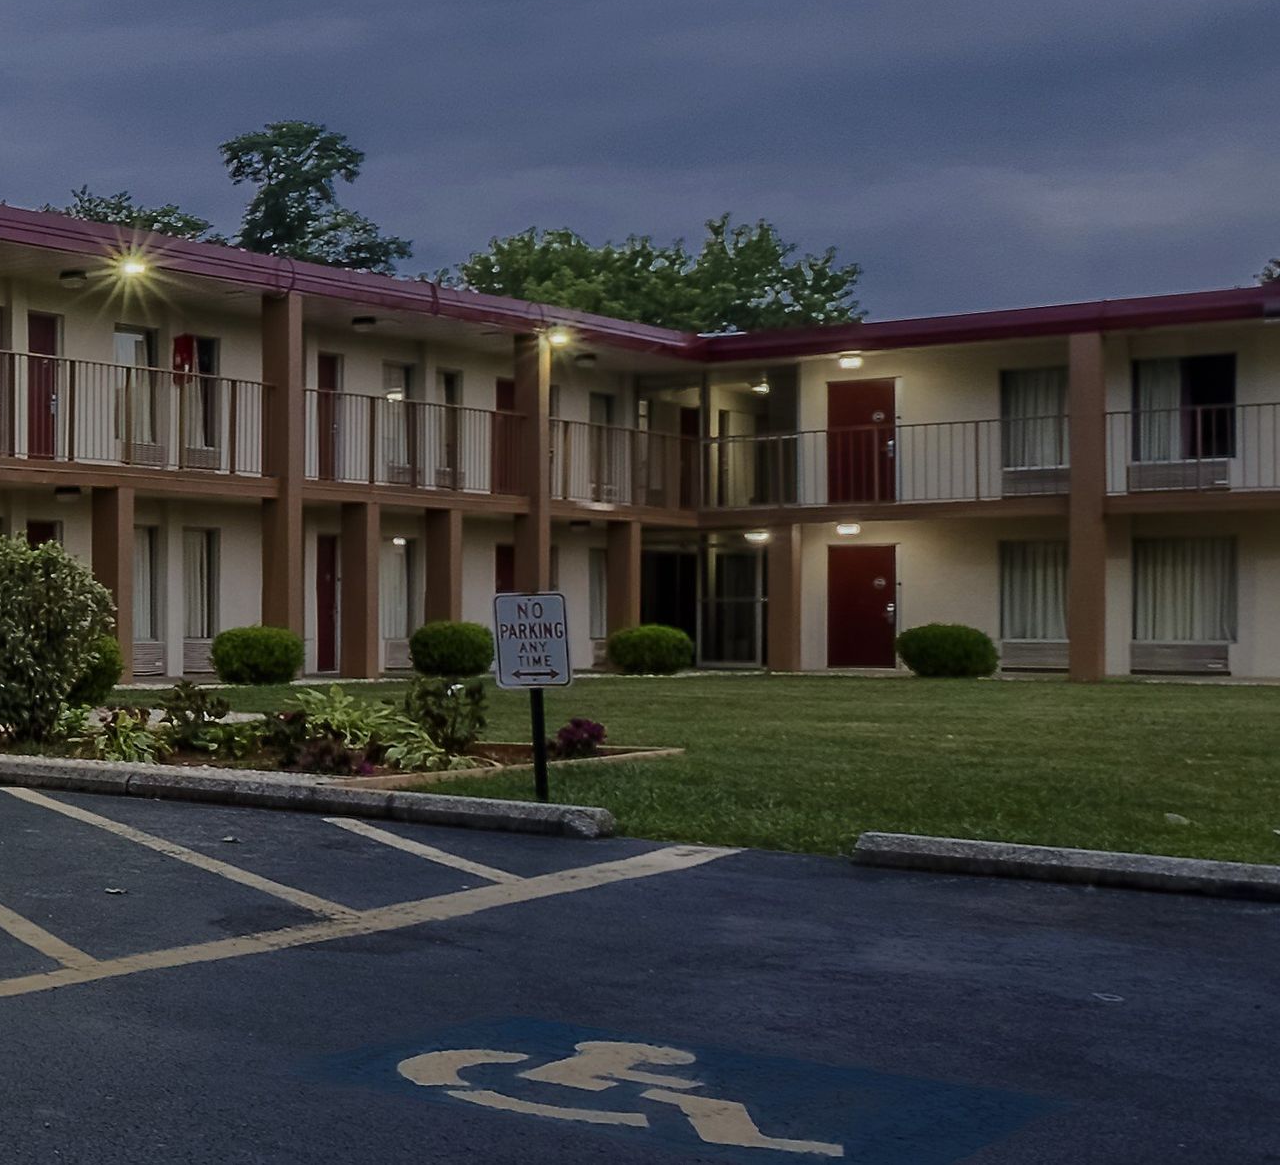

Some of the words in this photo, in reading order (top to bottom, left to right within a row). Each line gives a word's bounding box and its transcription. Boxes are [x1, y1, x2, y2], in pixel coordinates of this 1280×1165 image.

[517, 602, 544, 620] NO
[500, 622, 564, 639] PARKING
[519, 641, 548, 654] ANY
[517, 655, 552, 667] TIME
